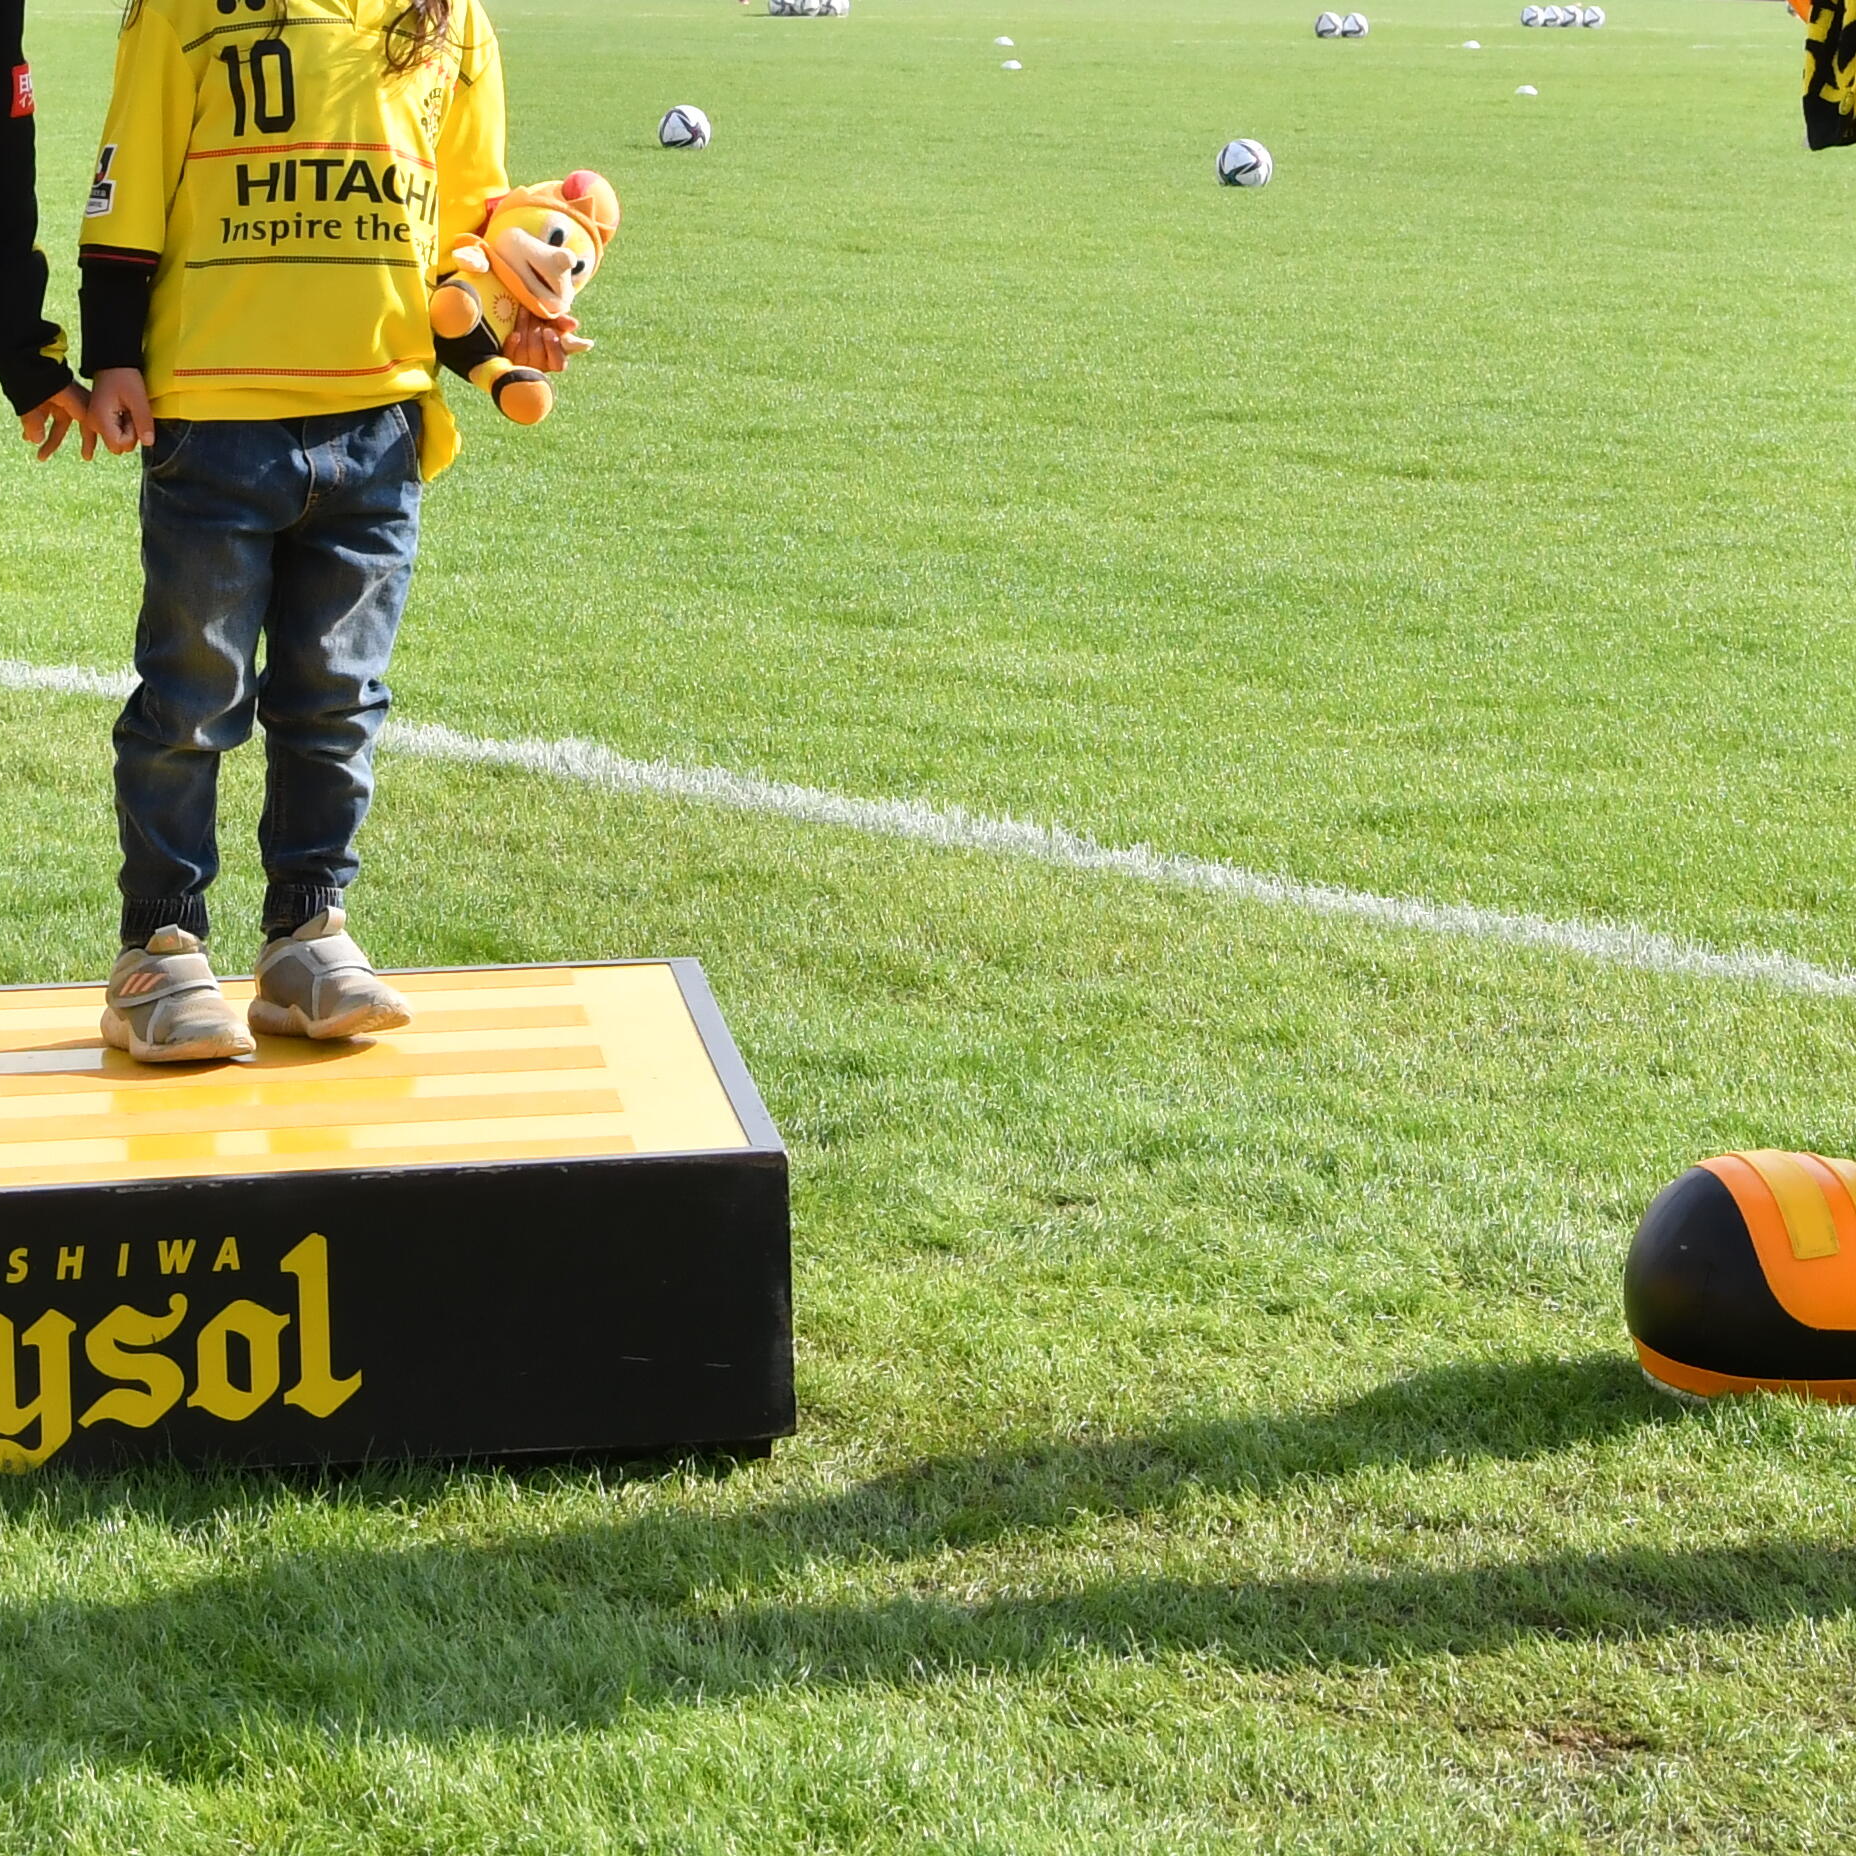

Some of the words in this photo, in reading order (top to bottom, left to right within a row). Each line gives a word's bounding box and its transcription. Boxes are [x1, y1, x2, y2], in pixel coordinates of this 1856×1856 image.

[219, 38, 296, 137] 10
[235, 158, 438, 226] HITACHI
[219, 211, 343, 246] Inspire
[354, 212, 411, 243] the
